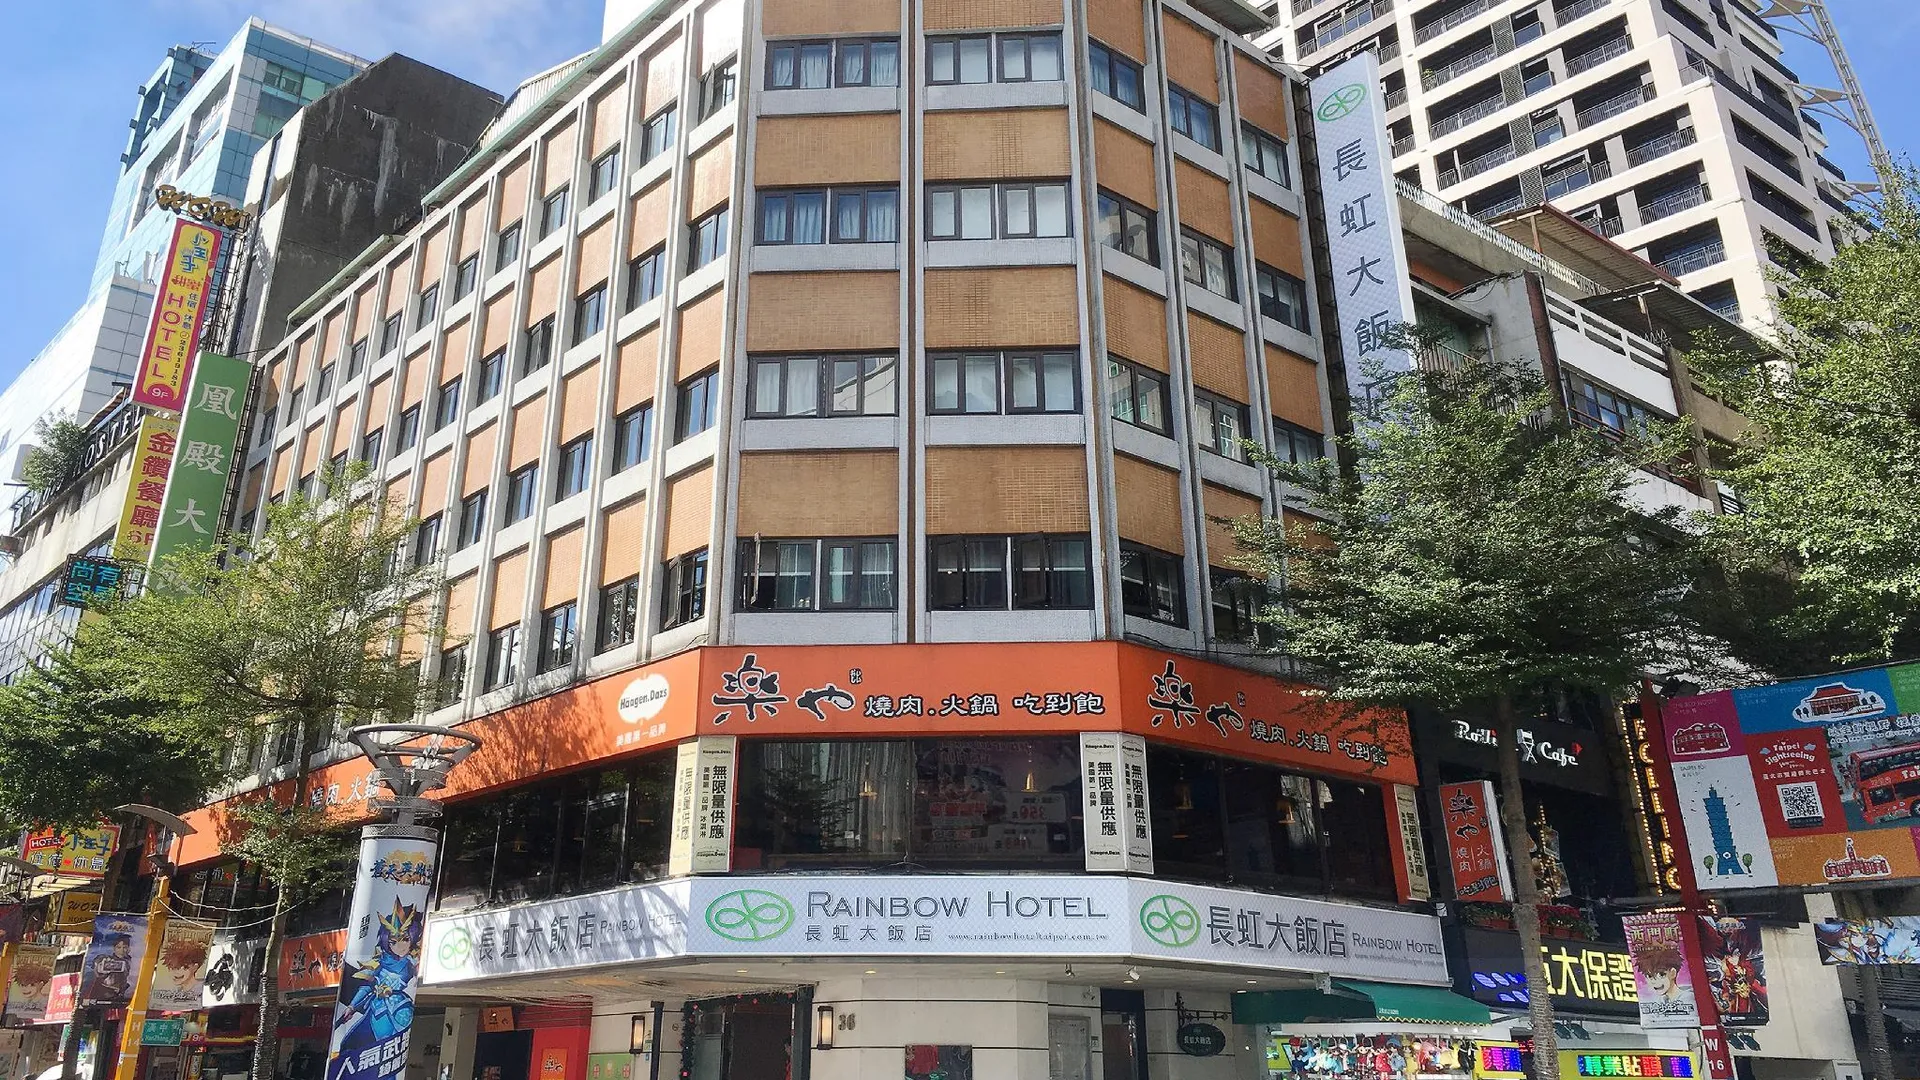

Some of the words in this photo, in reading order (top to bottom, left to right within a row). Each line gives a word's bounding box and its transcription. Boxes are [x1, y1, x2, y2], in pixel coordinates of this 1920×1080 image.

[151, 292, 184, 378] HOTEL
[151, 388, 168, 399] 9F
[1012, 692, 1105, 716] 吃到飽
[1337, 739, 1389, 766] 吃到飽
[1537, 741, 1579, 767] Cafe
[1765, 751, 1815, 765] Sightseeing
[1773, 741, 1801, 752] Taipei
[708, 765, 728, 839] 無限量供應
[1097, 761, 1118, 836] 無限量供應
[1131, 764, 1148, 840] 無限量供應
[1476, 844, 1493, 871] 火鍋
[1457, 875, 1500, 896] 吃到飽
[806, 890, 970, 918] RAINBOW
[986, 890, 1107, 918] HOTEL
[478, 911, 597, 963] 長虹大飯店
[804, 924, 933, 942] 長虹大飯店
[1207, 905, 1346, 958] 長虹大飯店
[1352, 932, 1402, 951] RAINBOW
[1406, 939, 1443, 955] HOTEL
[1629, 925, 1680, 944] 西門町
[838, 1013, 856, 1031] 36
[1704, 1038, 1719, 1052] W
[1708, 1059, 1725, 1071] 16
